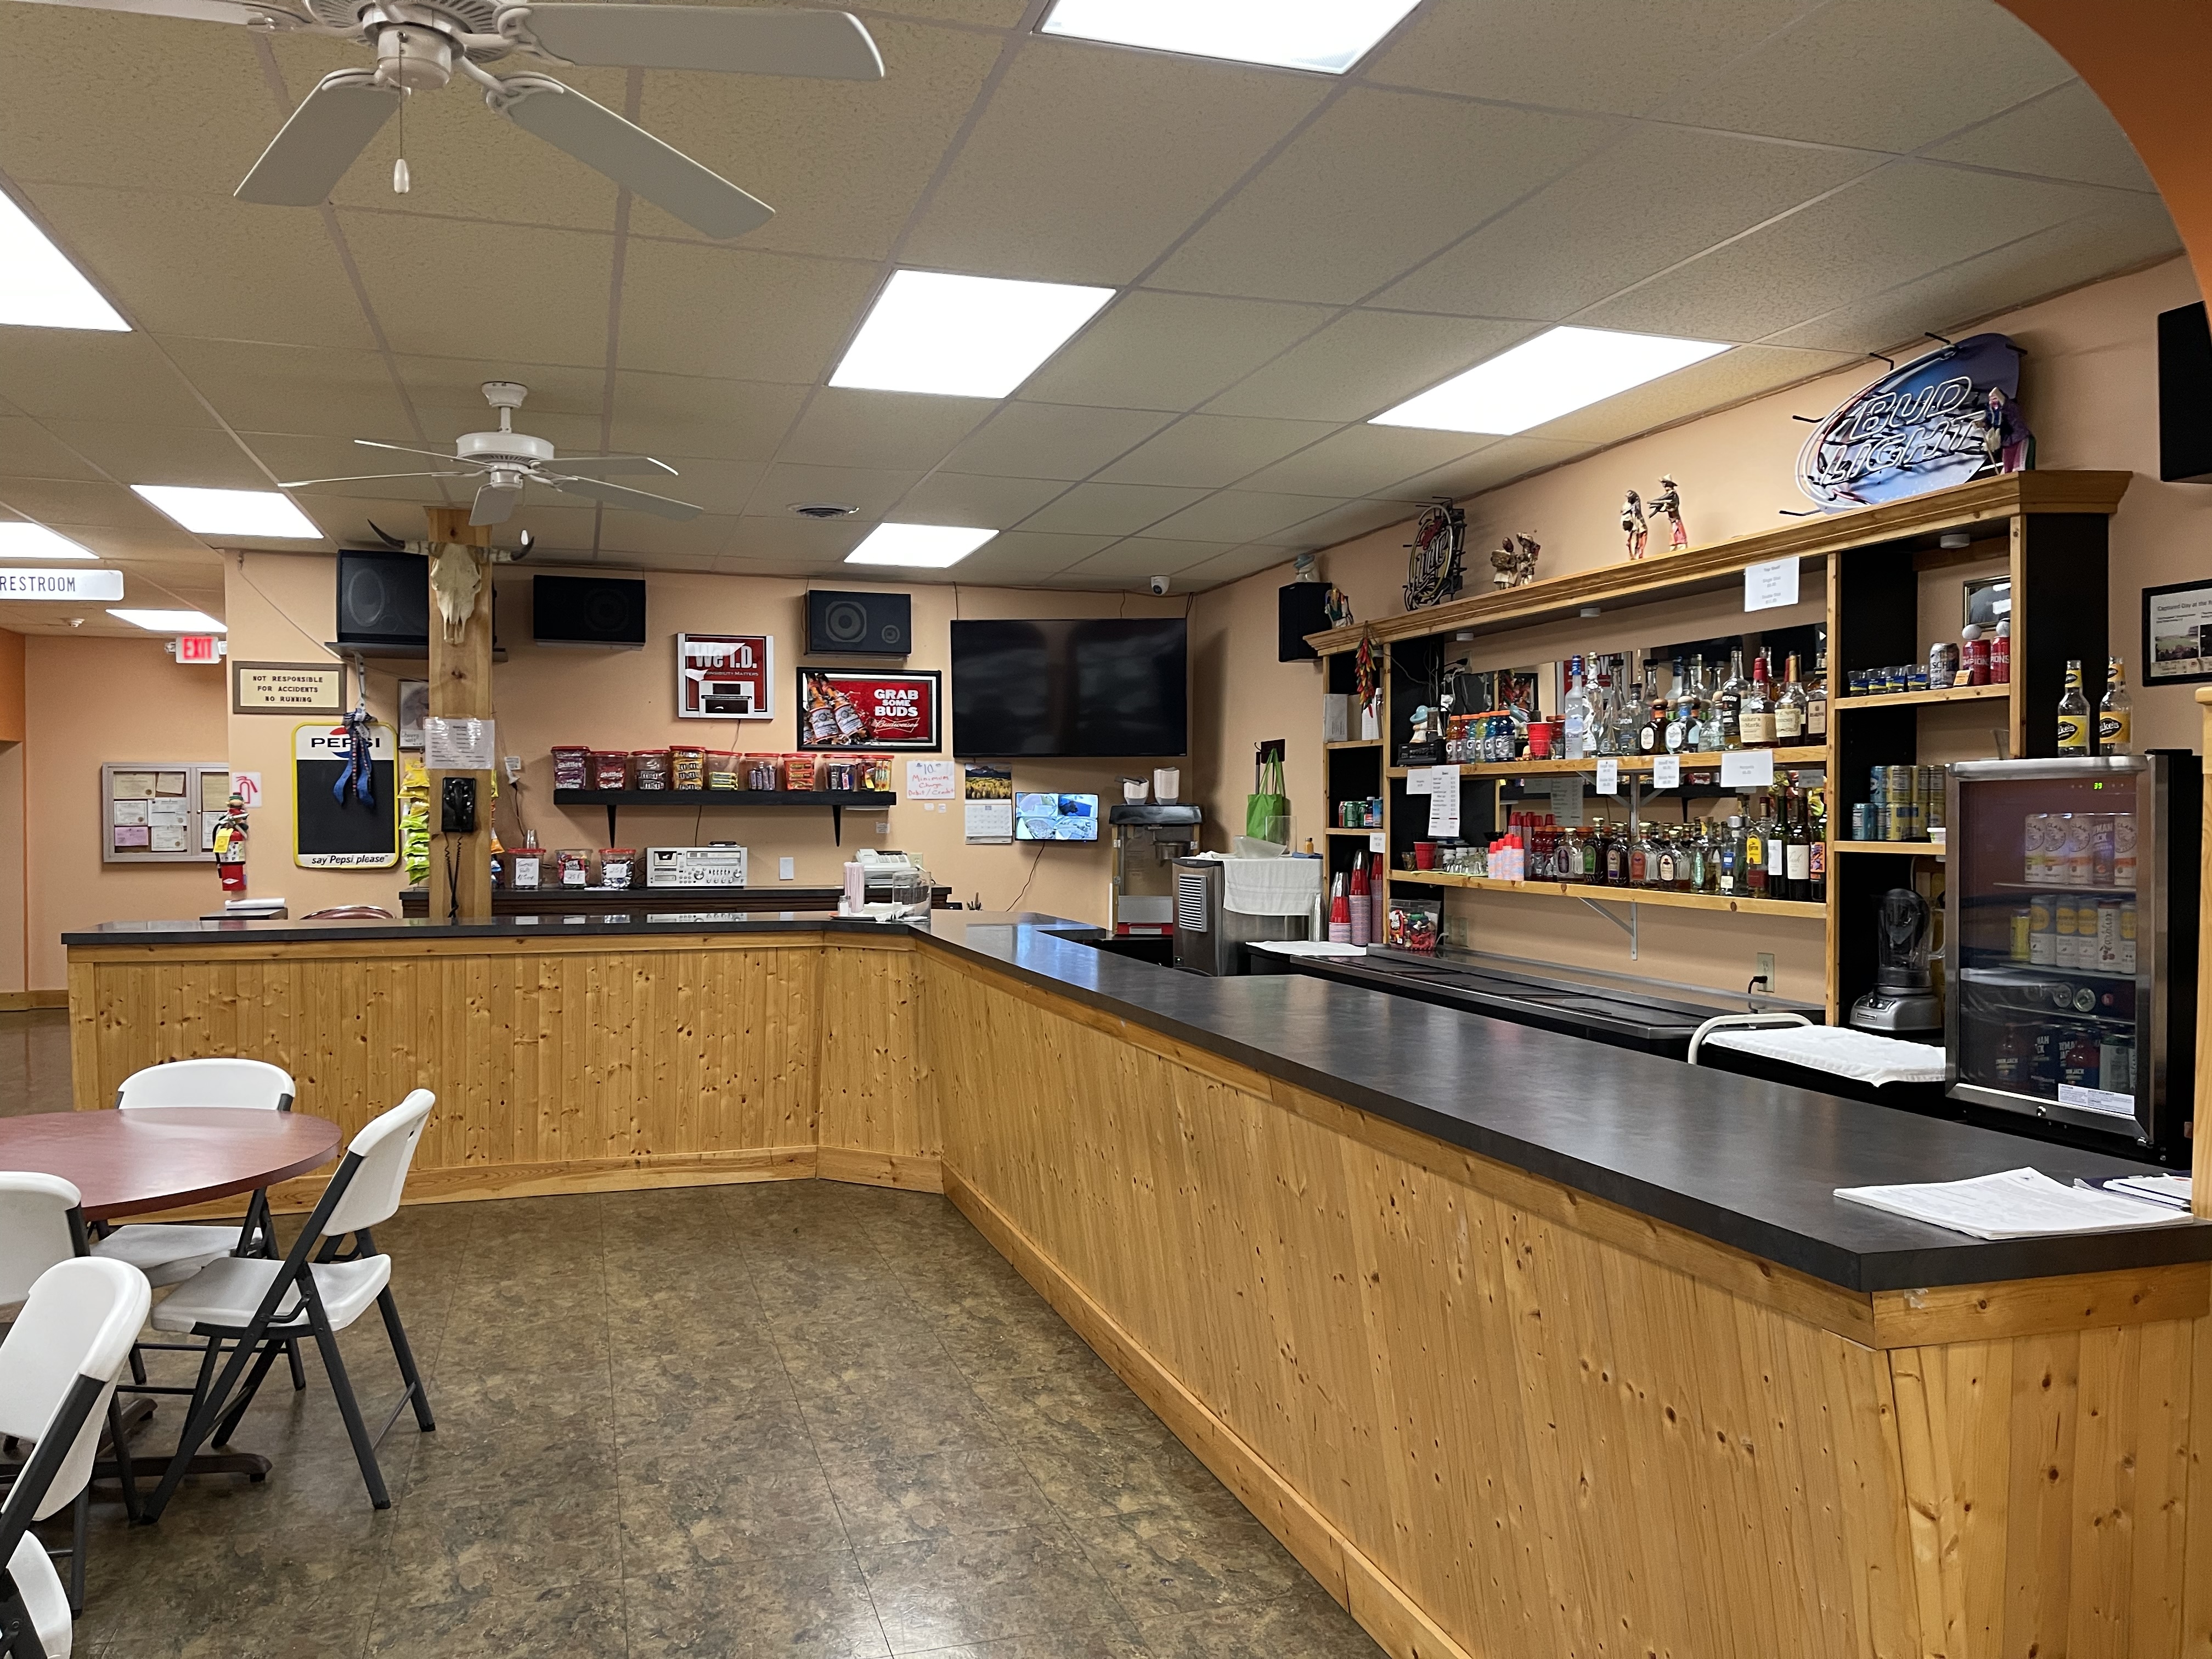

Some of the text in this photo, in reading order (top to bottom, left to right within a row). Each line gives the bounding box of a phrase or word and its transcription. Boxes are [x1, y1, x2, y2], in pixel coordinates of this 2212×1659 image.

[1849, 376, 1972, 439] BUD
[1820, 410, 1987, 486] LIGHT
[0, 577, 76, 591] RESTROOM
[183, 636, 213, 659] EXIT
[694, 644, 723, 668] We
[874, 689, 918, 700] GRAB
[874, 706, 918, 716] BUDS
[876, 720, 919, 728] Budweiser
